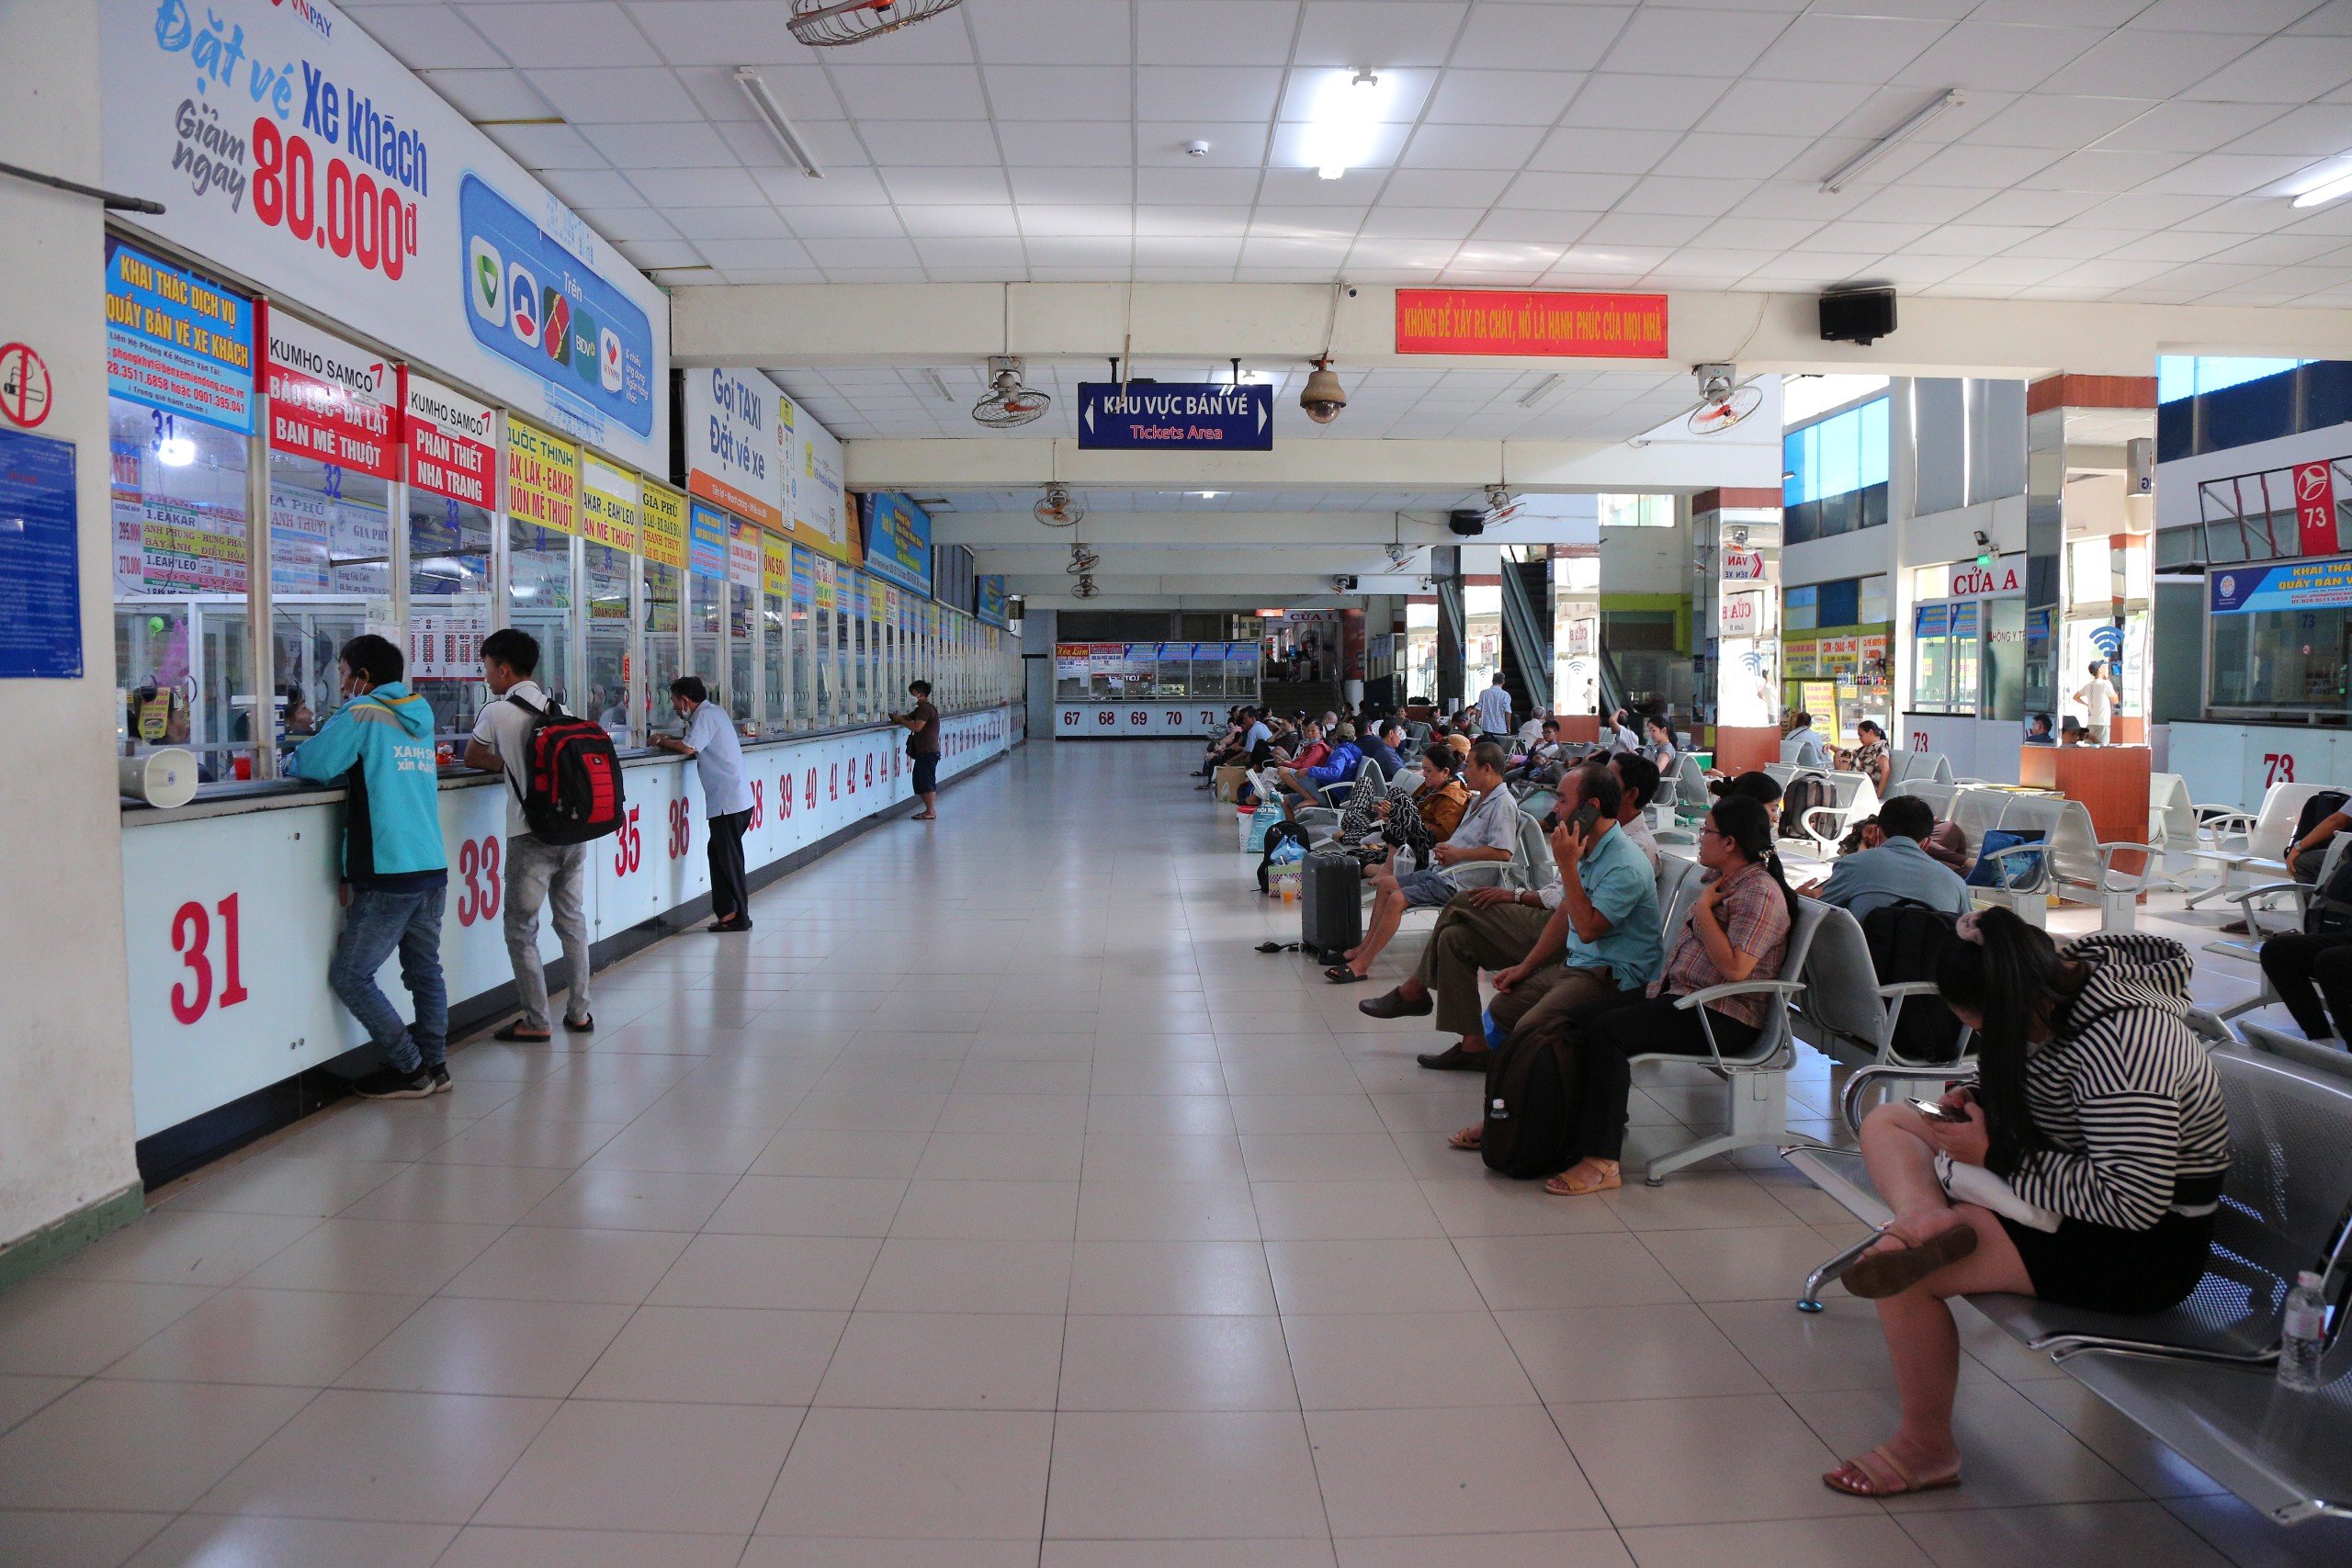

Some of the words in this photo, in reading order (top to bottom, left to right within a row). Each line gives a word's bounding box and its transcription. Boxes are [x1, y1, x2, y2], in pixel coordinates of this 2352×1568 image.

[155, 0, 246, 96] Đặt
[250, 59, 295, 120] vé
[301, 59, 339, 144] Xe
[175, 98, 245, 164] Giảm
[172, 141, 246, 213] ngay
[120, 254, 153, 291] KHAI
[155, 273, 188, 306] THÁC
[191, 287, 219, 319] DỊCH
[221, 298, 237, 329] VỤ
[563, 270, 582, 301] Trên
[145, 308, 173, 341] BÁN
[175, 318, 190, 347] VÉ
[194, 326, 209, 354] XE
[211, 333, 249, 368] KHÁCH
[1405, 300, 1436, 337] KHÔNG
[1475, 309, 1487, 339] RA
[1533, 303, 1545, 340] LÀ
[1548, 310, 1573, 345] HẠNH
[1576, 304, 1600, 340] PHÚC
[1644, 306, 1661, 342] NHÀ
[575, 334, 595, 357] BIDV
[107, 360, 168, 390] 28.3511.6858
[171, 380, 192, 399] hoặc
[269, 336, 322, 373] KUMHO
[326, 359, 373, 393] SAMCO
[411, 390, 448, 422] KUMHO
[450, 411, 483, 436] SAMCO
[712, 367, 734, 422] Gọi
[737, 381, 762, 432] TAXI
[1103, 396, 1141, 415] KHU
[1145, 393, 1182, 420] VỰC
[1186, 393, 1223, 415] BÁN
[1226, 393, 1248, 415] VÉ
[152, 409, 174, 452] 31
[276, 416, 309, 447] BAN
[313, 426, 336, 456] MÊ
[341, 435, 381, 470] THUỘT
[709, 414, 734, 471] Đặt
[736, 436, 750, 472] vé
[752, 449, 764, 480] xe
[1130, 424, 1184, 440] Tickets
[1187, 424, 1223, 440] Area
[416, 428, 450, 461] PHAN
[452, 444, 483, 473] THIẾT
[509, 447, 522, 480] ĂK
[540, 442, 573, 468] THỊNH
[323, 463, 343, 500] 32
[417, 459, 443, 485] NHA
[446, 468, 482, 502] TRANG
[146, 509, 196, 527] 1.EAKAR
[270, 495, 287, 508] IA
[510, 481, 529, 513] UÔN
[532, 491, 545, 519] MÊ
[583, 491, 602, 514] AKAR
[642, 492, 659, 510] GIA
[2304, 506, 2327, 529] 73
[144, 524, 163, 535] ANH
[271, 512, 294, 528] ANH
[583, 516, 594, 536] AN
[596, 520, 608, 544] MÊ
[1953, 566, 1995, 595] CỬA
[2003, 569, 2018, 590] A
[2292, 566, 2324, 576] KHAI
[2327, 561, 2352, 573] THÁ
[2314, 576, 2342, 587] BÁN
[1987, 630, 2011, 642] HÒNG
[2012, 632, 2017, 641] Y
[2301, 614, 2316, 628] 73
[1064, 711, 1081, 726] 67
[1098, 711, 1115, 726] 68
[1131, 711, 1148, 726] 69
[1166, 711, 1182, 726] 70
[1200, 711, 1215, 726] 71
[1913, 731, 1928, 752] 73
[806, 765, 818, 810] 40
[829, 761, 838, 802] 41
[846, 756, 856, 795] 42
[865, 751, 873, 788] 43
[2264, 753, 2295, 789] 73
[779, 773, 792, 821] 39
[615, 805, 640, 878] 35
[669, 795, 690, 861] 36
[458, 835, 501, 928] 33
[170, 892, 248, 1026] 31
